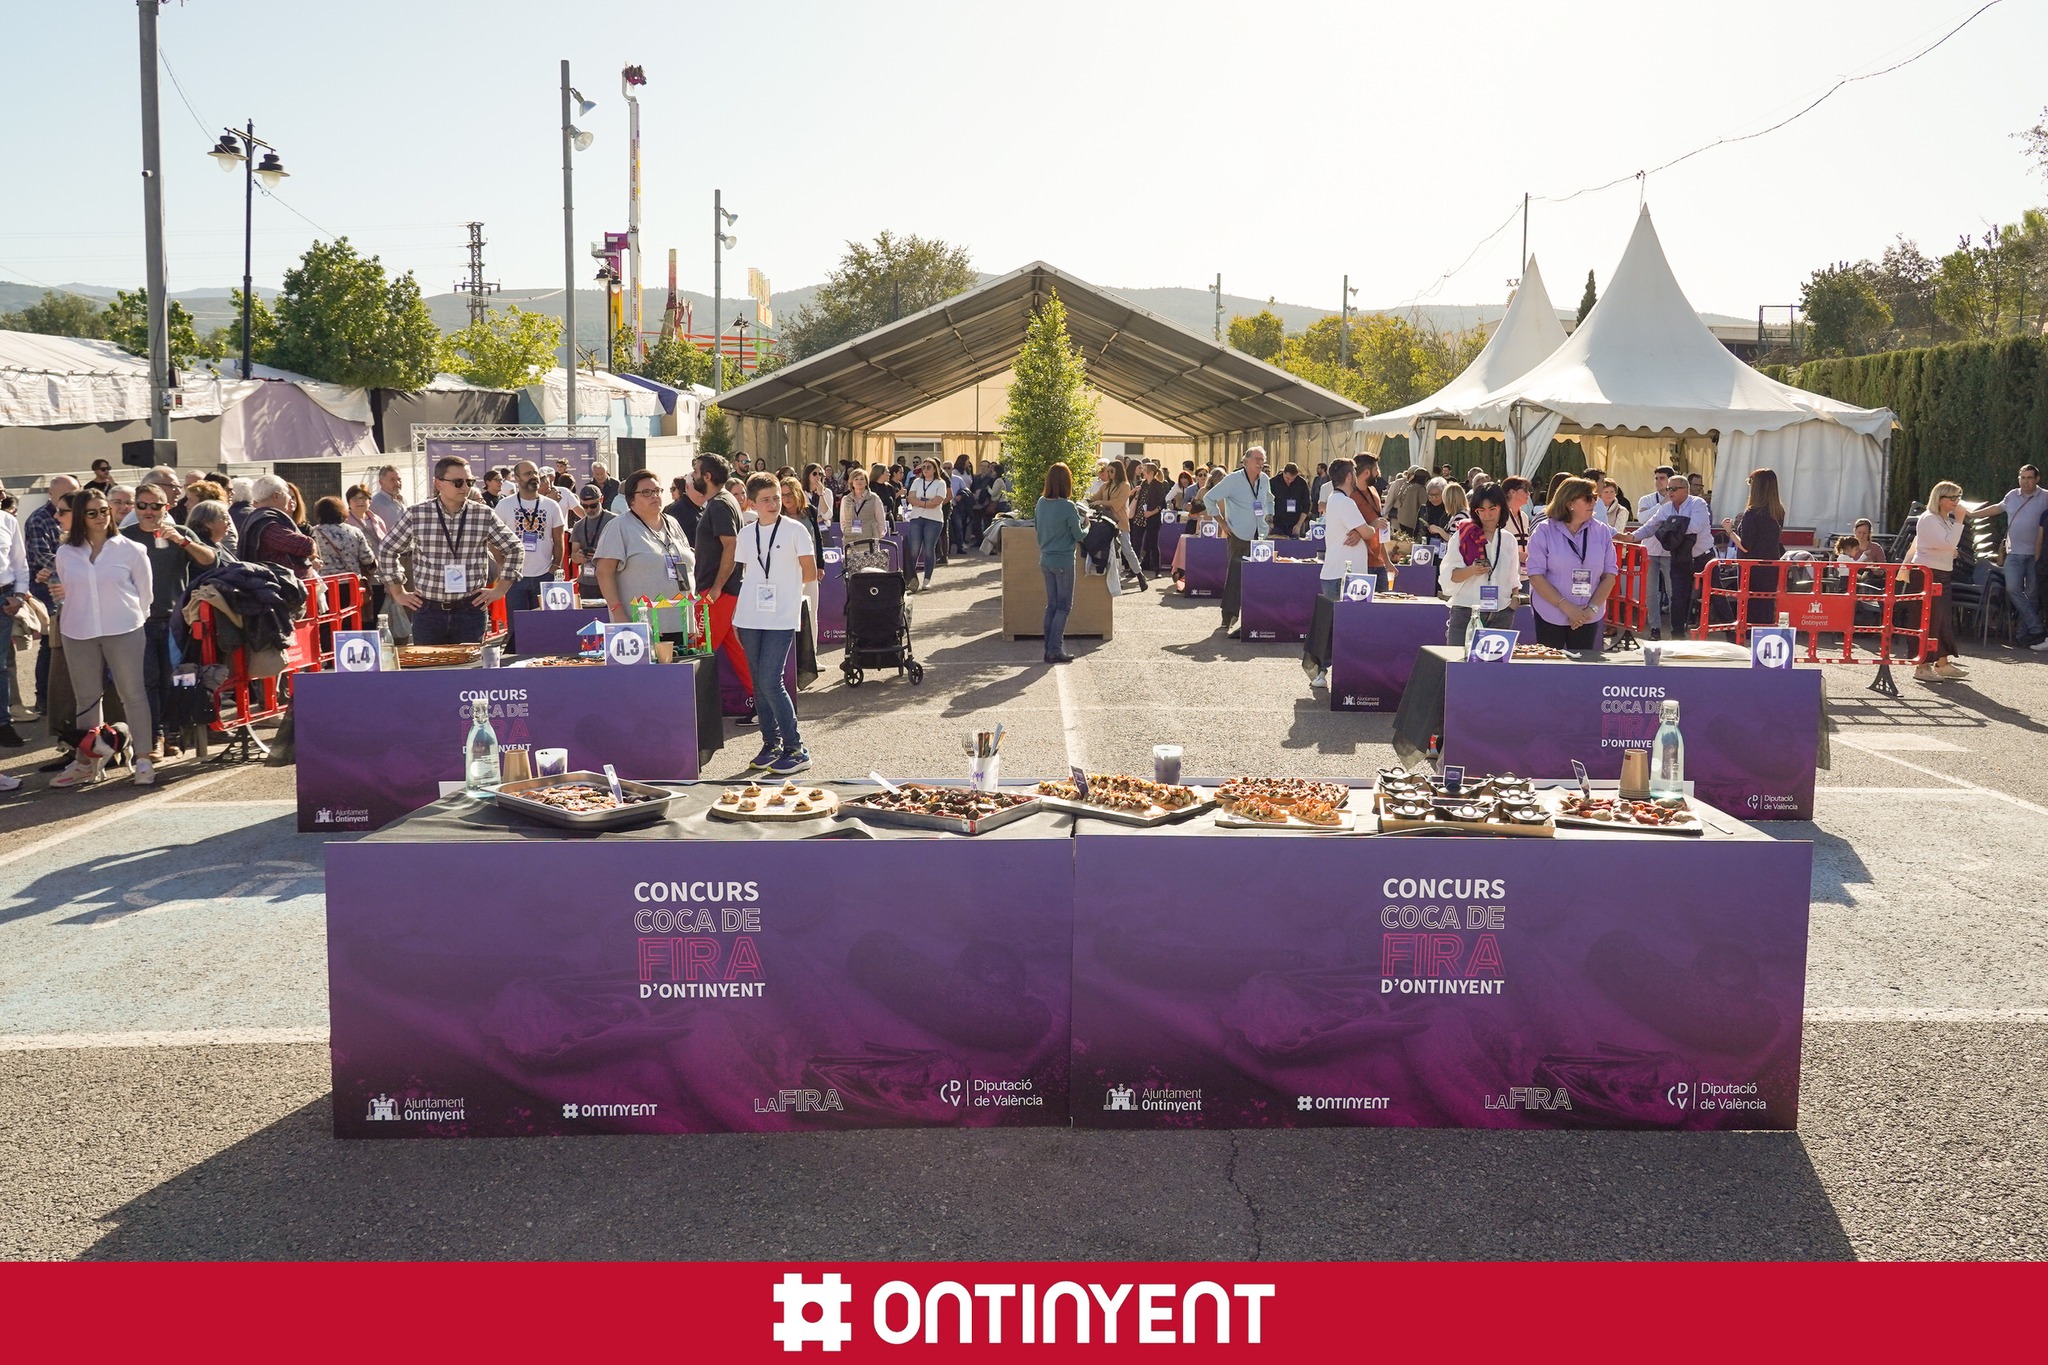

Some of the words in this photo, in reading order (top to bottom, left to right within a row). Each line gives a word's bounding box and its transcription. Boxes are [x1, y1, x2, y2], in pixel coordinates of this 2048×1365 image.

[1416, 552, 1430, 560] A.9
[1350, 584, 1368, 596] A.6
[550, 592, 568, 605] A.8
[616, 638, 640, 656] A.3
[1480, 640, 1506, 654] A.2
[1764, 642, 1783, 660] A.1
[347, 646, 370, 664] A.4
[459, 688, 528, 702] CONCURS
[1602, 686, 1666, 698] CONCURS
[507, 703, 530, 718] DE
[1600, 700, 1642, 714] COCA
[1601, 739, 1654, 748] D'ONTINYE
[1764, 794, 1794, 803] Diputació
[336, 808, 368, 816] Ajuntament
[336, 815, 368, 824] Ontinyent
[634, 881, 760, 902] CONCURS
[1382, 878, 1506, 900] CONCURS
[634, 908, 716, 933] COCA
[722, 908, 762, 932] DE
[1380, 904, 1462, 930] COCA
[1466, 906, 1506, 930] DE
[638, 936, 766, 981] FIRA
[1382, 933, 1506, 977] FIRA
[640, 982, 766, 999] D'ONTINYENT
[1380, 978, 1505, 994] D'ONTINYENT
[974, 1079, 1033, 1092] Diputació
[1701, 1082, 1758, 1096] Diputació
[974, 1094, 990, 1106] de
[992, 1094, 1043, 1106] València
[1142, 1088, 1202, 1100] Ajuntament
[404, 1096, 464, 1110] Ajuntament
[1142, 1098, 1202, 1113] Ontinyent
[1316, 1096, 1390, 1110] ONTINYENT
[1700, 1098, 1715, 1110] de
[1716, 1097, 1766, 1110] València
[404, 1108, 465, 1123] Ontinyent
[582, 1104, 658, 1118] ONTINYENT
